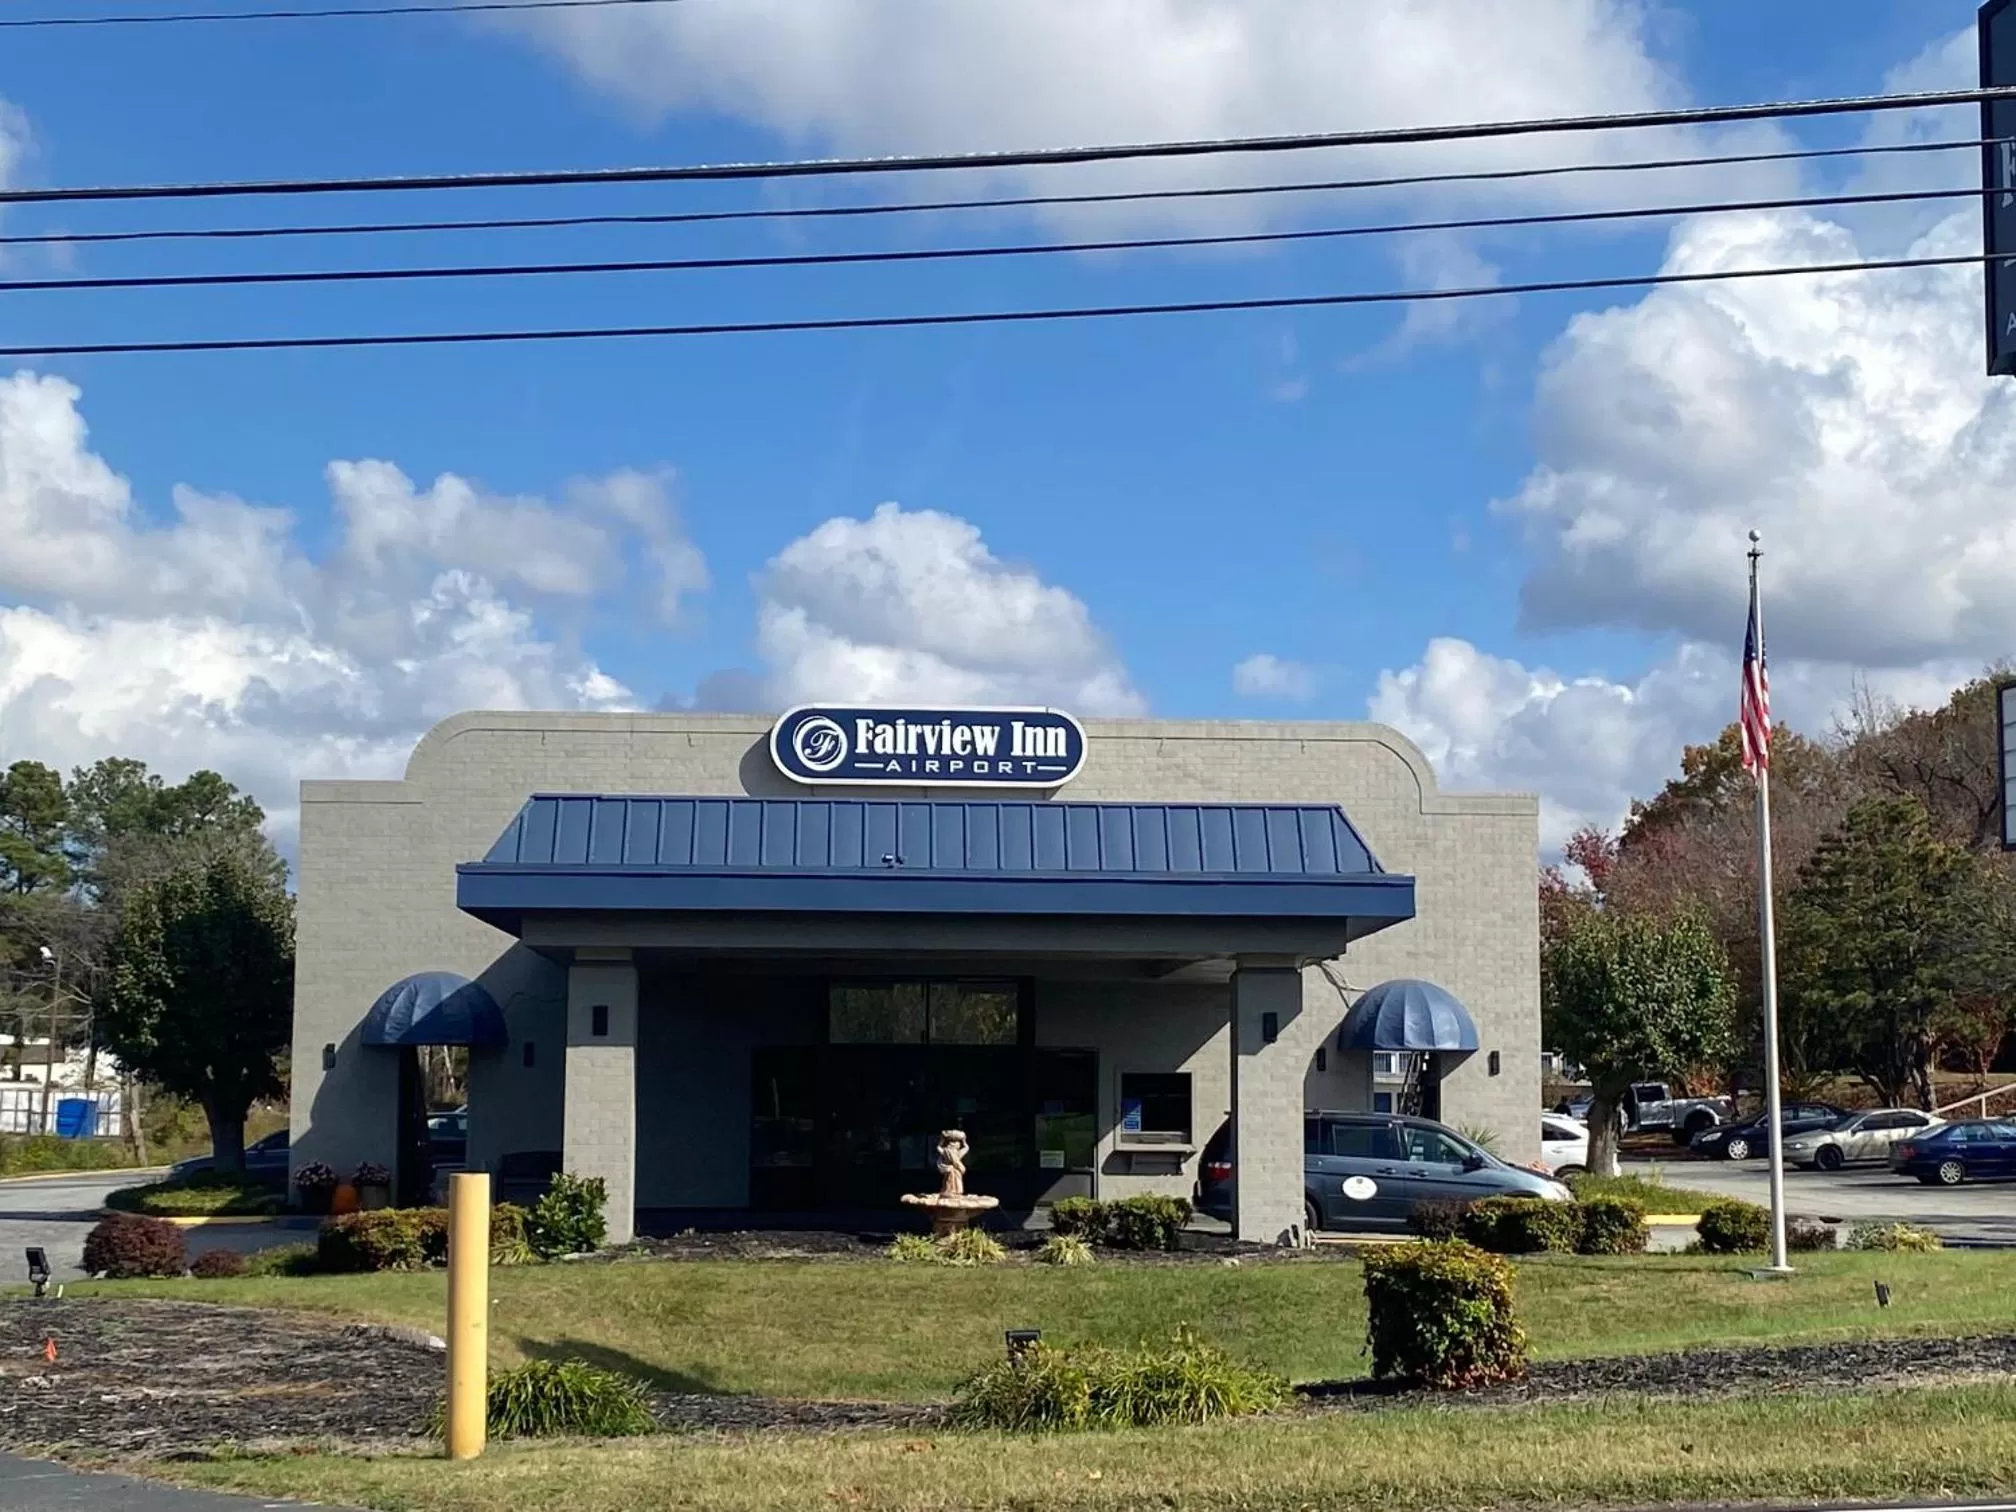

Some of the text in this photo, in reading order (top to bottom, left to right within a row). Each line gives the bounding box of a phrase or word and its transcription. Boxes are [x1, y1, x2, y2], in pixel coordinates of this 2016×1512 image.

[855, 718, 1067, 757] Fairview Inn
[886, 759, 1036, 775] AIRPORT
